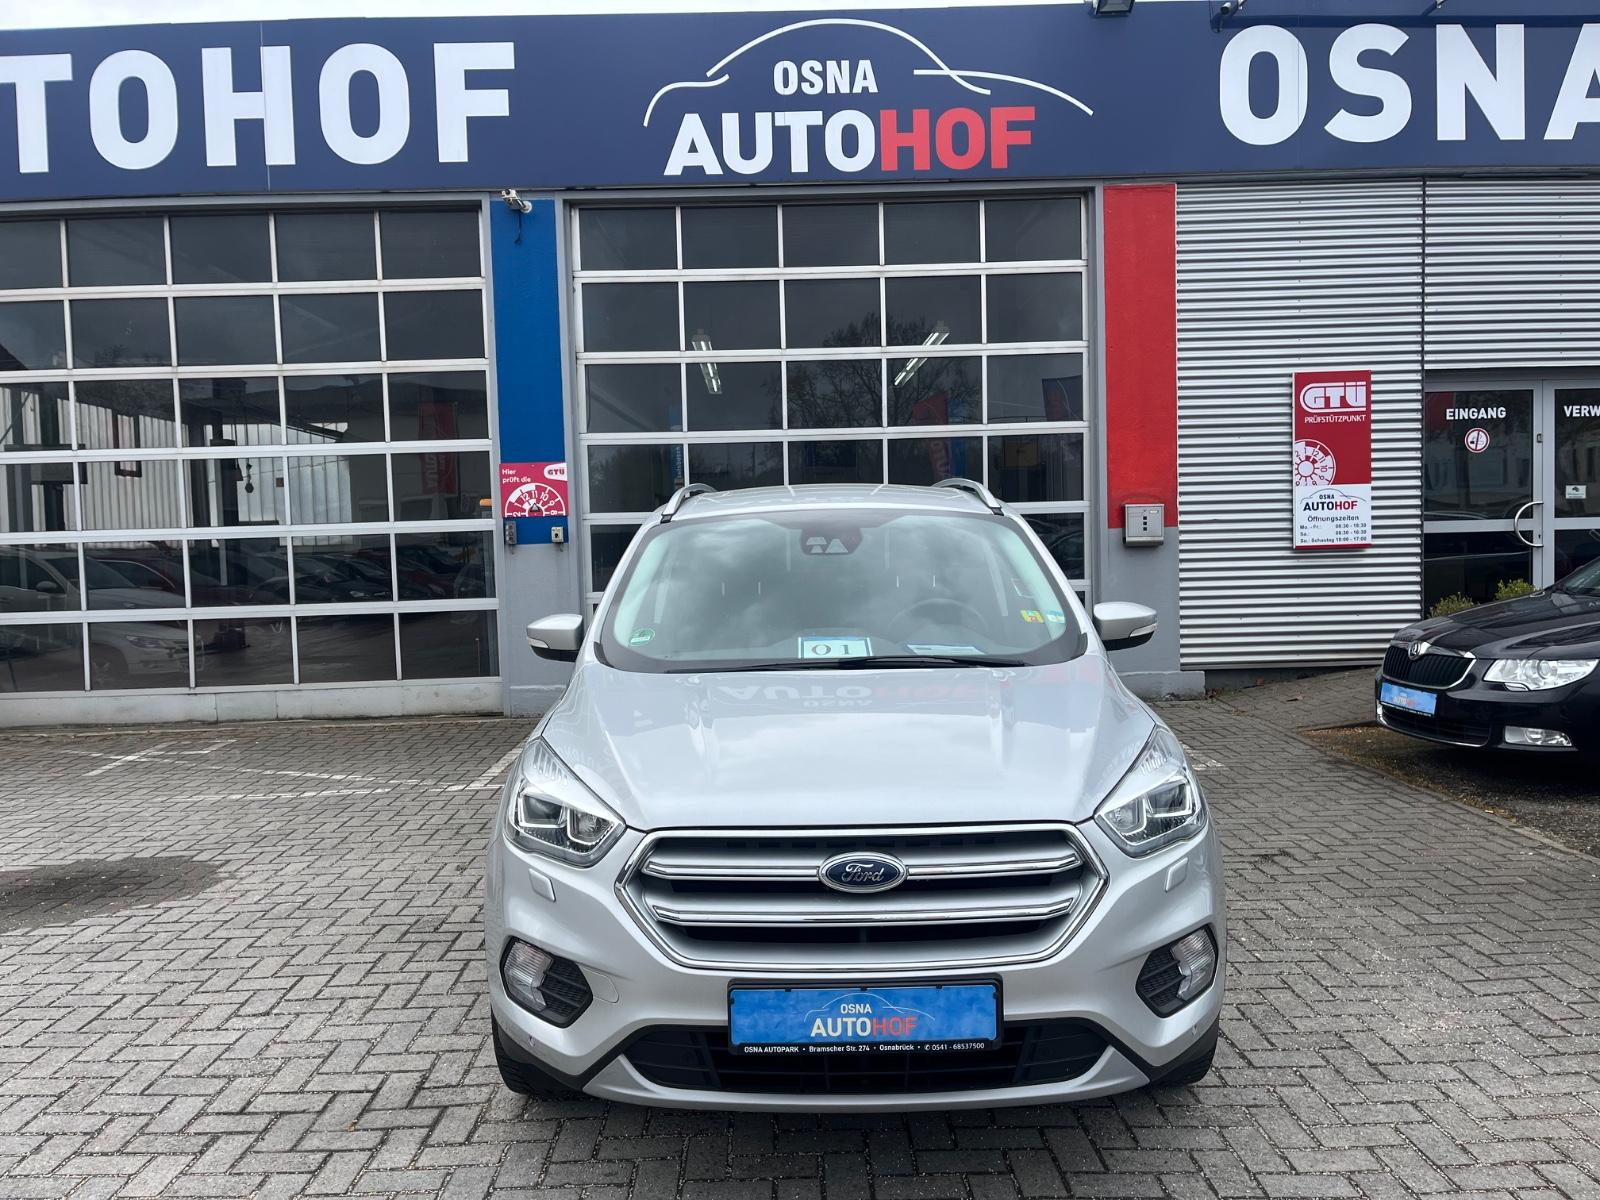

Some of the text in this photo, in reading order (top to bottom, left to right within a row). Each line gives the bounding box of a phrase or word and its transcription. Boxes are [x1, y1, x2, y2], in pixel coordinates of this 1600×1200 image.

[773, 59, 878, 96] OSNA
[1219, 23, 1600, 146] OSNA
[0, 41, 515, 174] TOHOF
[663, 106, 1036, 176] AUTOHOF
[1301, 382, 1367, 410] GTÜ
[1304, 414, 1367, 423] PRÜFSTÜTZPUNKT
[1445, 407, 1507, 420] EINGANG
[1563, 405, 1600, 417] VERW
[1303, 501, 1358, 511] AUTOHOF
[1307, 514, 1359, 523] Öffnungszeiten
[841, 863, 885, 882] Ford
[840, 1003, 872, 1014] OSNA
[810, 1016, 917, 1038] AUTOHOF
[953, 1042, 985, 1050] 68537500
